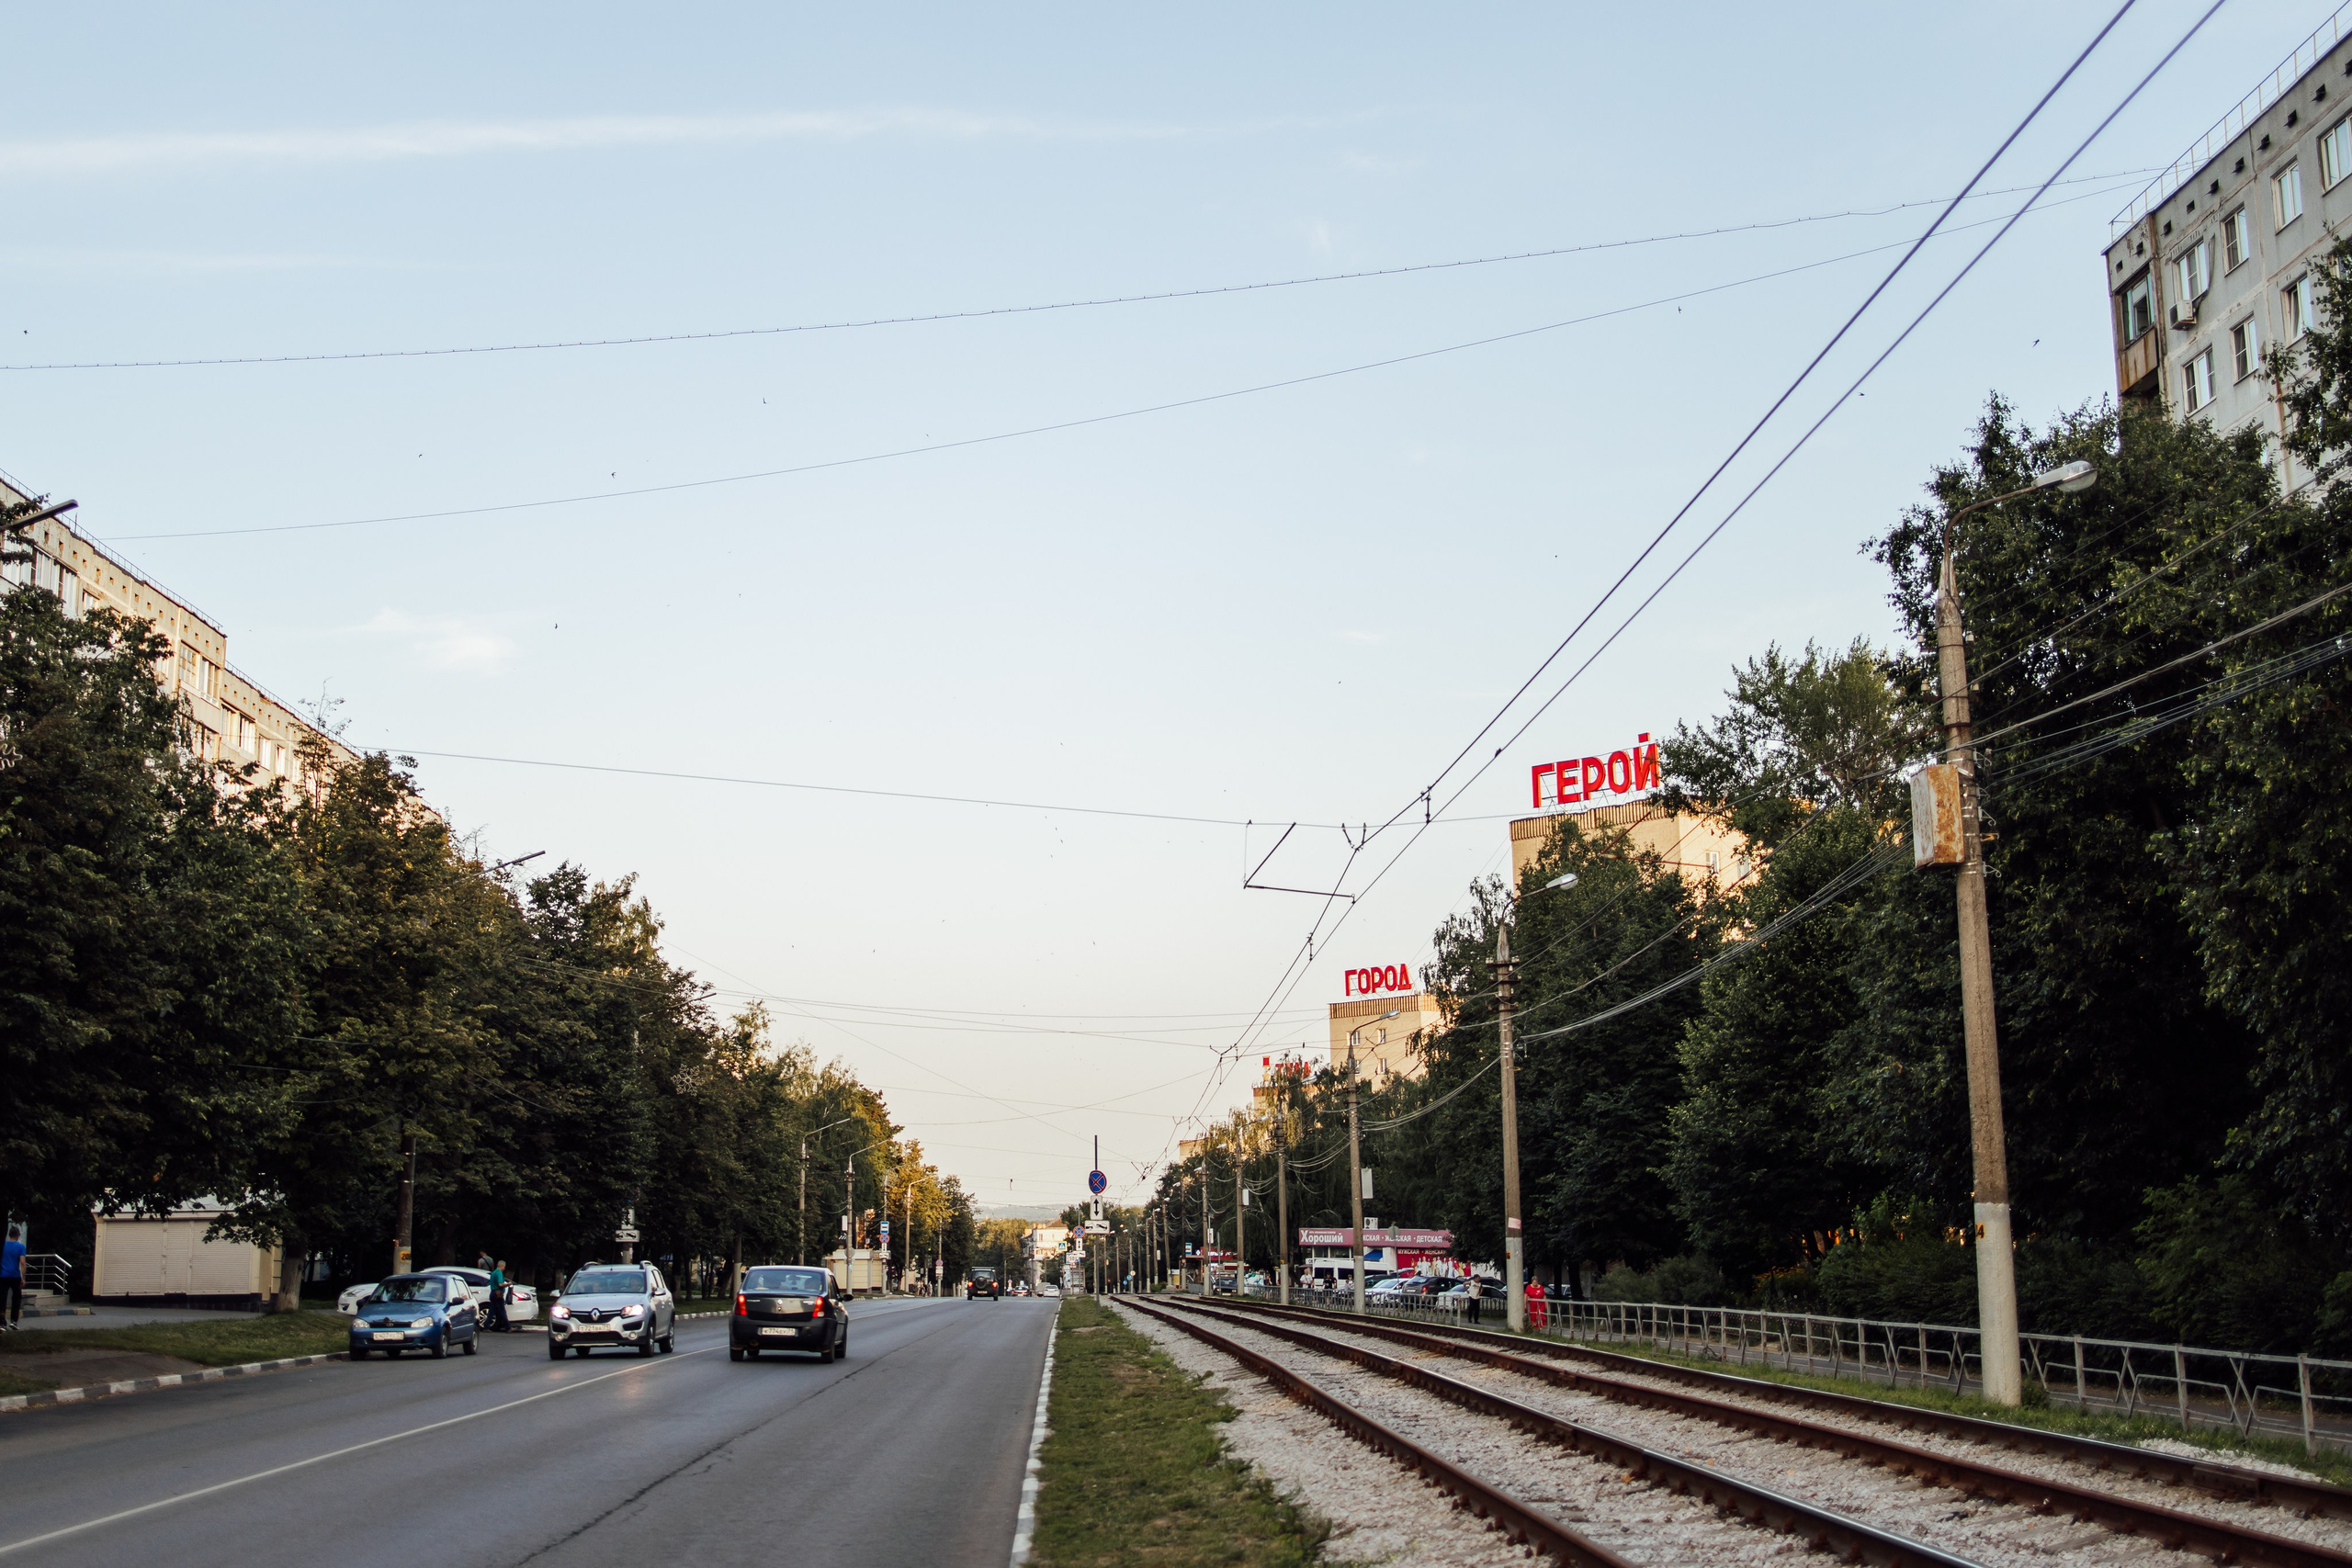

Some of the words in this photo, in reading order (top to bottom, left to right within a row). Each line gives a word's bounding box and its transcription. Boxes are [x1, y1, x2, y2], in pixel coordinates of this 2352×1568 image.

[1532, 732, 1660, 808] ГЕРОЙ
[1344, 963, 1412, 997] ГОРОД
[1300, 1229, 1343, 1245] Хороший
[1416, 1235, 1442, 1244] ДЕТСКАЯ
